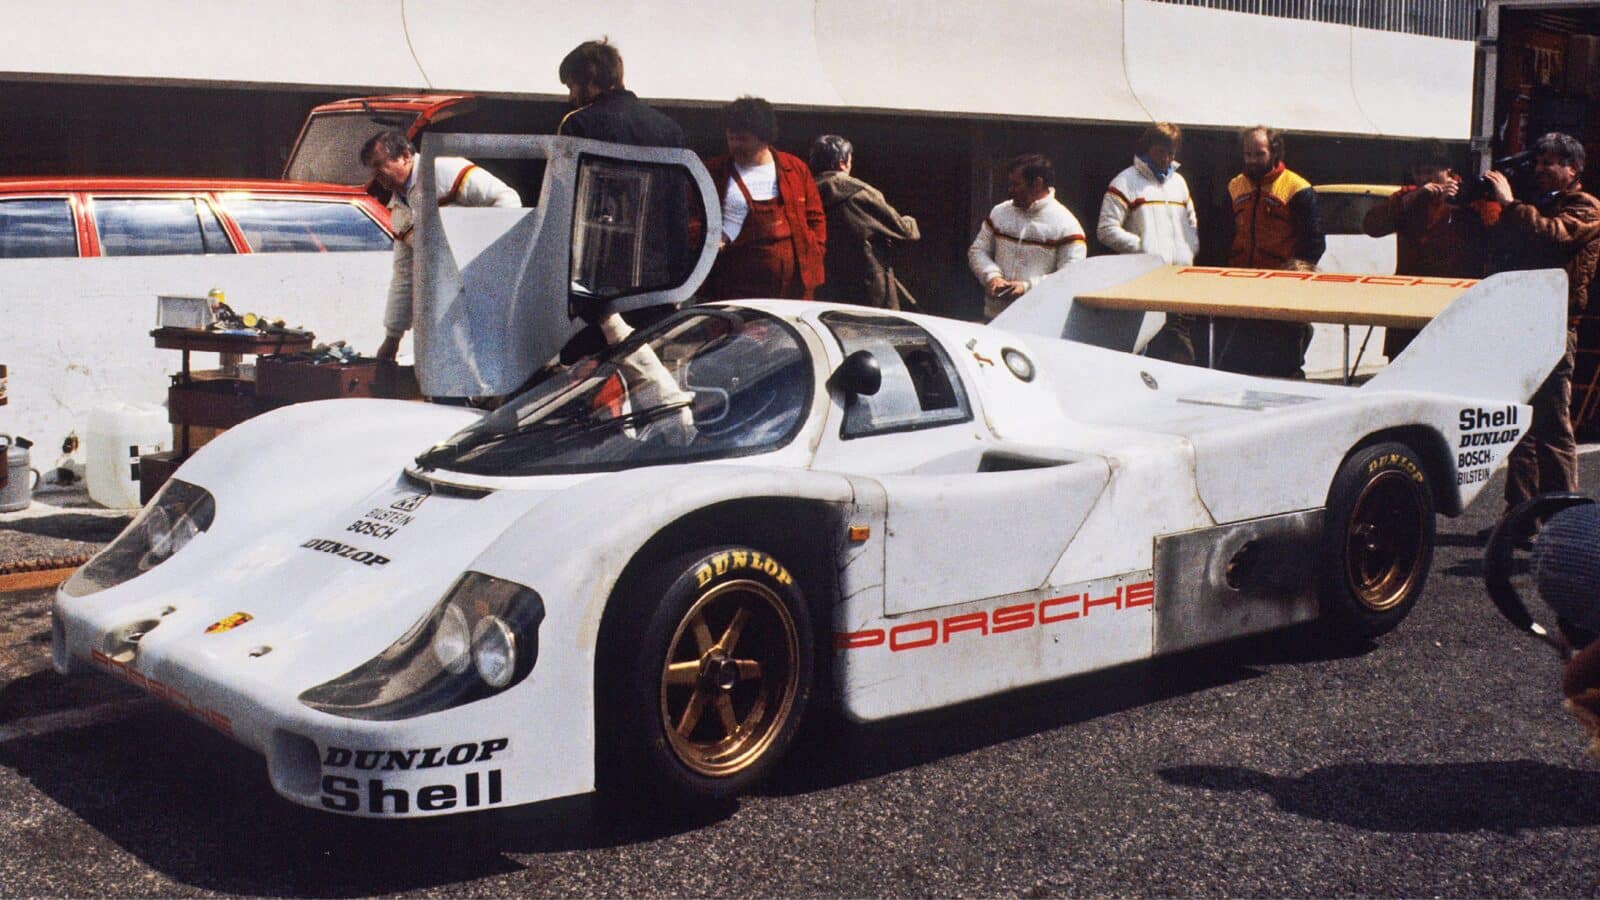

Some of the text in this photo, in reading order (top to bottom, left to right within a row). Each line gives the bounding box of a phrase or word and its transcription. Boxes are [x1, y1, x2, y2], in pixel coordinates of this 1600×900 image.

[1459, 405, 1517, 431] Shell
[1459, 429, 1520, 448] DUNLOP
[1369, 453, 1424, 482] DUNLOP
[1458, 449, 1490, 468] BOSCH
[1457, 468, 1490, 486] BILSTEIN
[346, 520, 398, 540] BOSCH
[300, 538, 391, 566] DUNLOP
[695, 551, 792, 588] DUNLOP
[831, 580, 1154, 656] PORSCHE
[323, 738, 509, 770] DUNLOP
[321, 769, 503, 814] Shell
